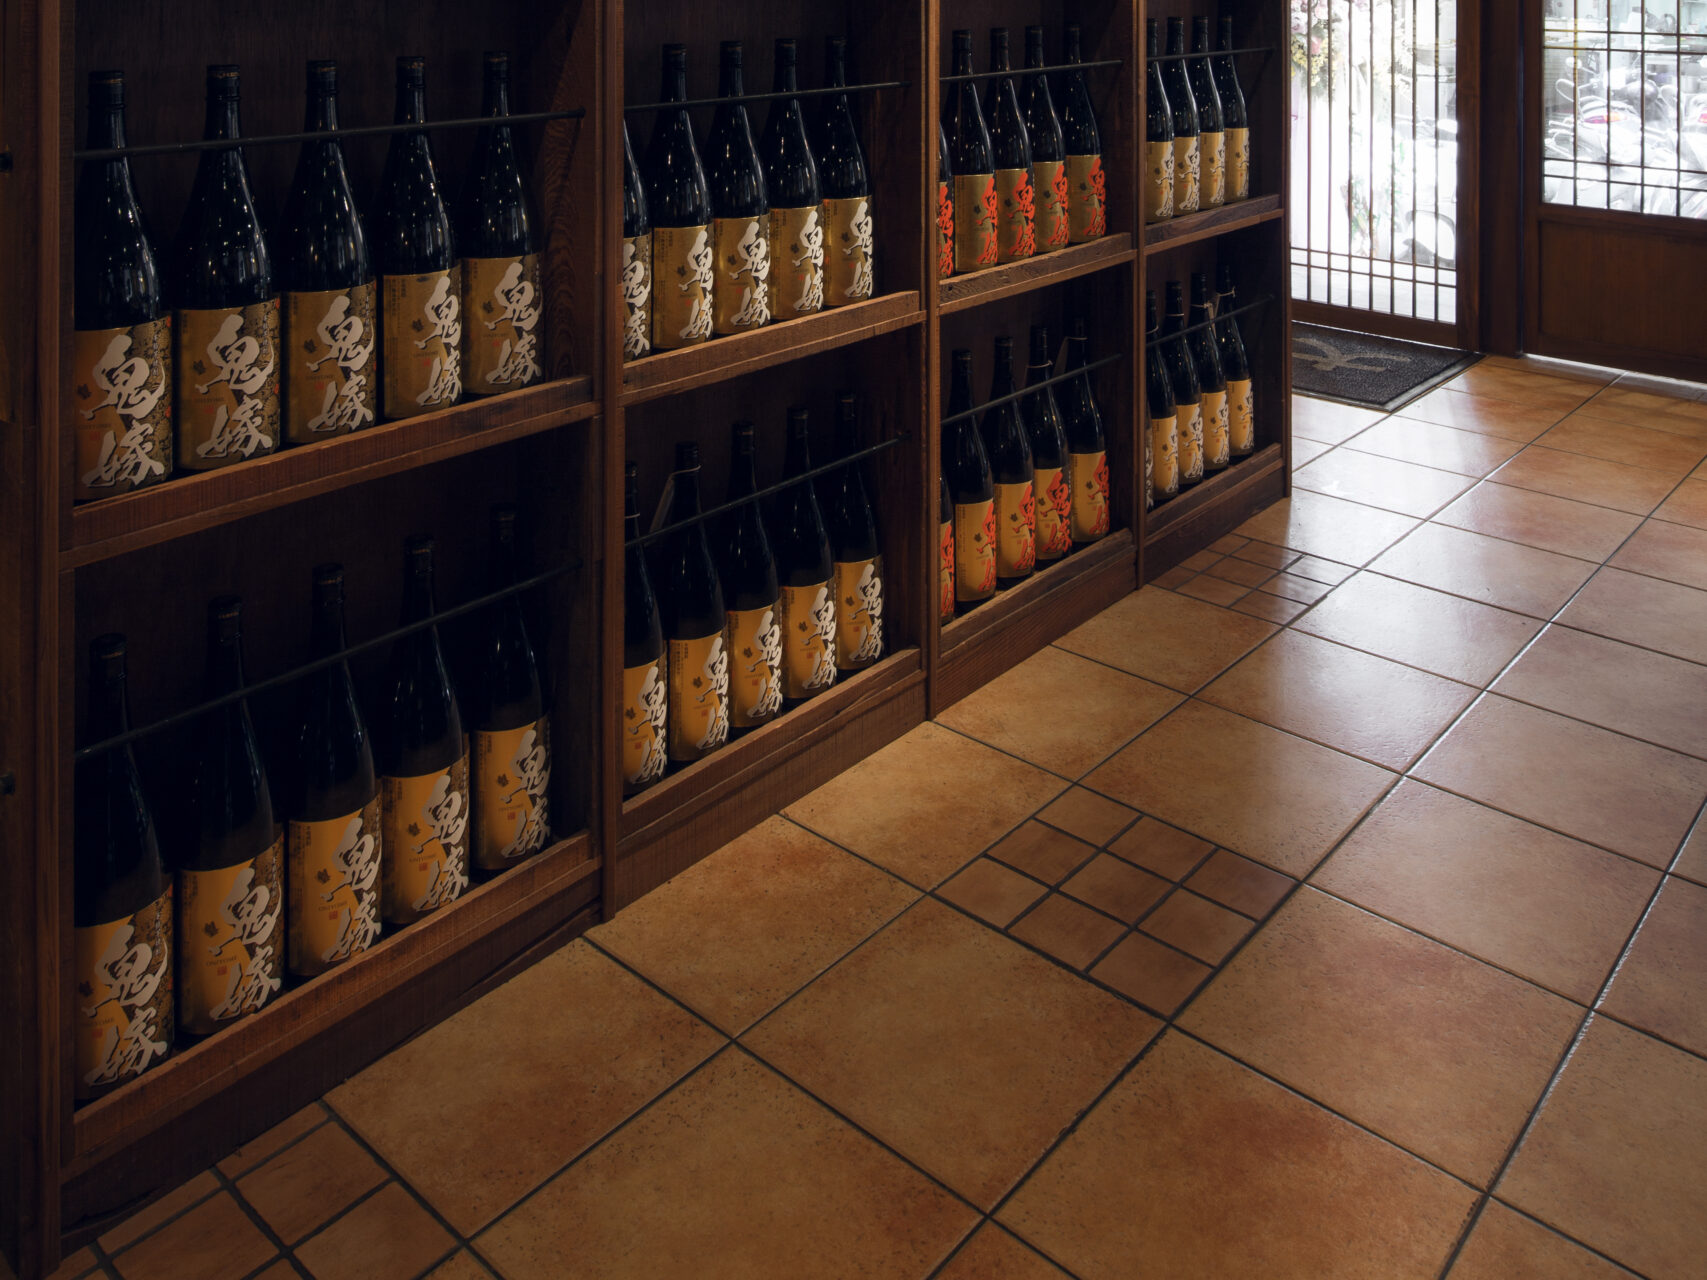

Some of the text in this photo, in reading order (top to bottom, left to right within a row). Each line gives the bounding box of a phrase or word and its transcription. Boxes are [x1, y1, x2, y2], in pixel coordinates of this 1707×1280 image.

[678, 231, 714, 339] 鬼嫁
[729, 221, 771, 326] 鬼嫁
[792, 210, 824, 312] 鬼嫁
[843, 201, 873, 298] 鬼嫁
[306, 295, 374, 432] 鬼嫁
[414, 276, 462, 406] 鬼嫁
[484, 262, 544, 385] 鬼嫁
[80, 334, 166, 487] 鬼嫁
[195, 314, 274, 458] 鬼嫁
[1040, 471, 1072, 553] 鬼嫁
[746, 611, 783, 718] 鬼嫁
[801, 587, 838, 690] 鬼嫁
[849, 564, 884, 662] 鬼嫁
[628, 666, 668, 785] 鬼嫁
[696, 637, 730, 750] 鬼嫁
[411, 775, 470, 912] 鬼嫁
[500, 730, 552, 858] 鬼嫁
[208, 868, 282, 1021] 鬼嫁
[320, 818, 382, 963] 鬼嫁
[81, 925, 168, 1087] 鬼嫁
